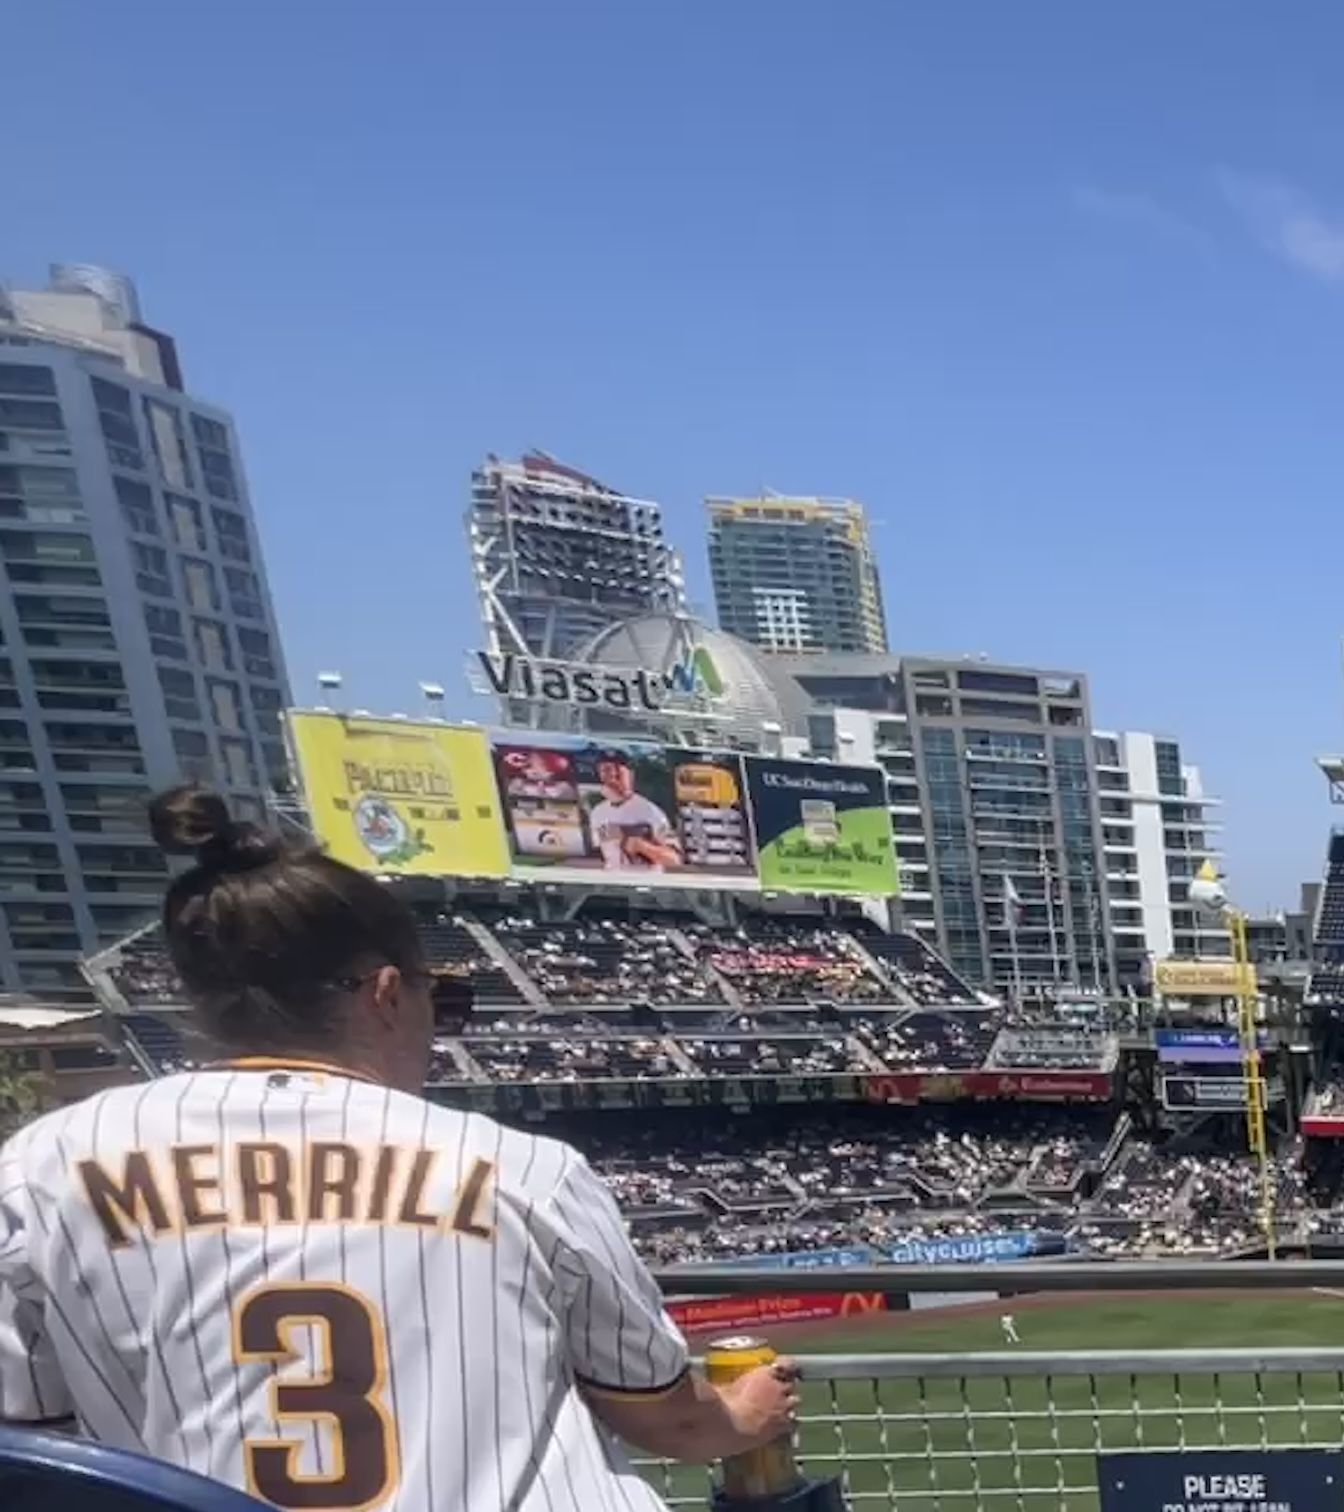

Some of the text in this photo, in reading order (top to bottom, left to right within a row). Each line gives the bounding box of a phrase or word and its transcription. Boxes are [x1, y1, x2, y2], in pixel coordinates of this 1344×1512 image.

[478, 652, 660, 710] Viasat
[75, 1140, 498, 1250] MERRILL
[1184, 1474, 1266, 1499] PLEASE
